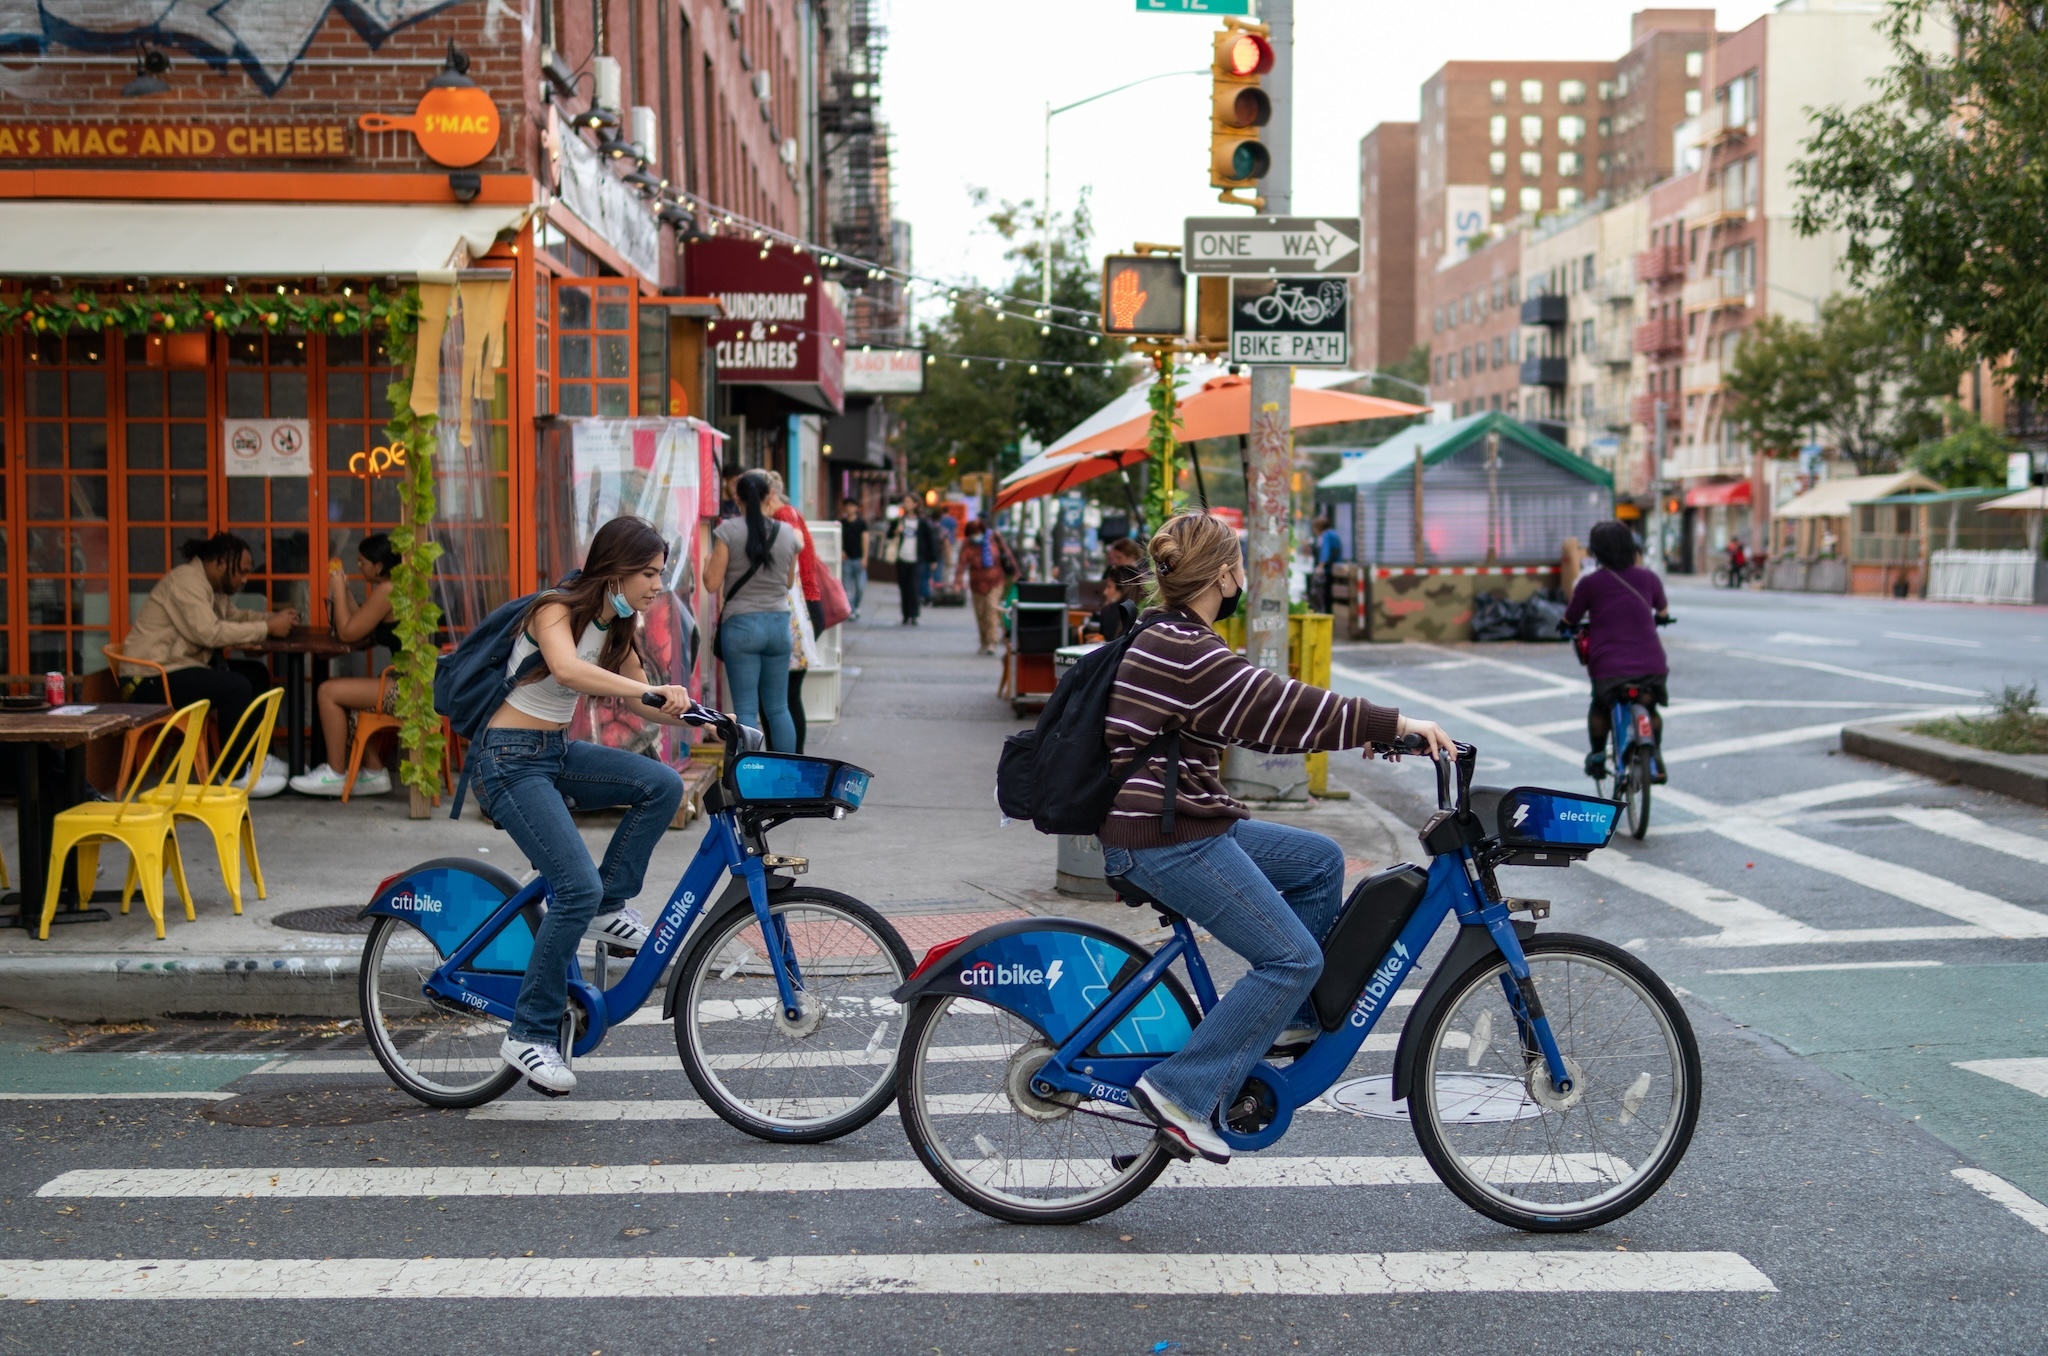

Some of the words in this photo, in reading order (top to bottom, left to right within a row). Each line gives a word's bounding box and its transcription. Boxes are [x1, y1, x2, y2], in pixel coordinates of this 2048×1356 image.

[425, 114, 489, 134] S'MAC
[52, 127, 128, 155] MAC
[139, 127, 216, 155] AND
[227, 126, 345, 154] CHEESE
[1200, 235, 1251, 256] ONE
[1282, 235, 1337, 256] WAY
[709, 293, 807, 320] AUNDROMAT
[751, 321, 766, 341] &
[716, 341, 798, 369] CLEANERS
[1240, 336, 1281, 356] BIKE
[1292, 336, 1339, 356] PATH
[349, 441, 405, 478] ope
[1559, 810, 1607, 823] electric
[391, 892, 413, 910] citi
[413, 894, 443, 912] bike
[654, 923, 676, 955] citi
[665, 890, 696, 929] bike
[959, 962, 994, 985] citi
[997, 963, 1044, 985] bike
[461, 991, 489, 1010] 17087
[1350, 994, 1378, 1028] citi
[1365, 957, 1403, 999] bike
